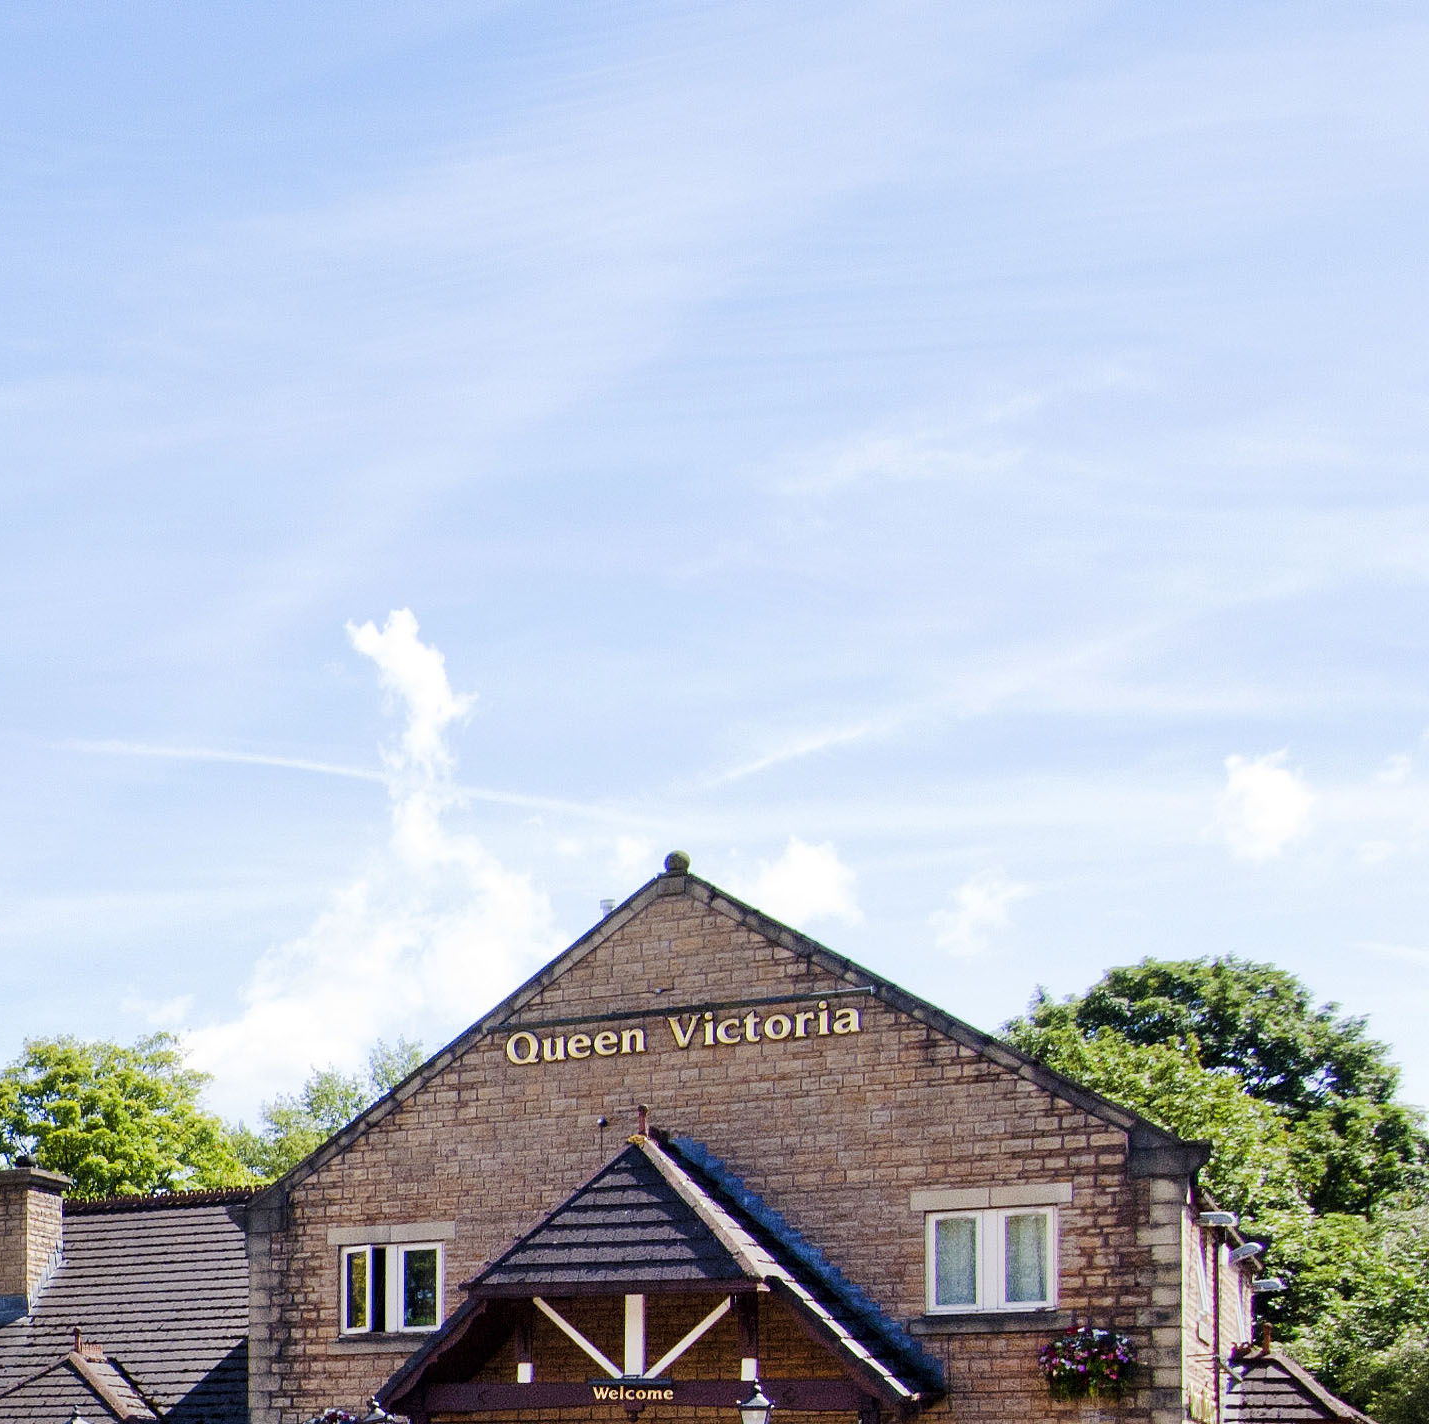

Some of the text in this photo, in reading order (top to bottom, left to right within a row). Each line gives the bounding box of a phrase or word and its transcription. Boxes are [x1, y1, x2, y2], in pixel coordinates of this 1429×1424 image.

[506, 1000, 863, 1065] Queen Victoria
[592, 1385, 674, 1401] Welcome
